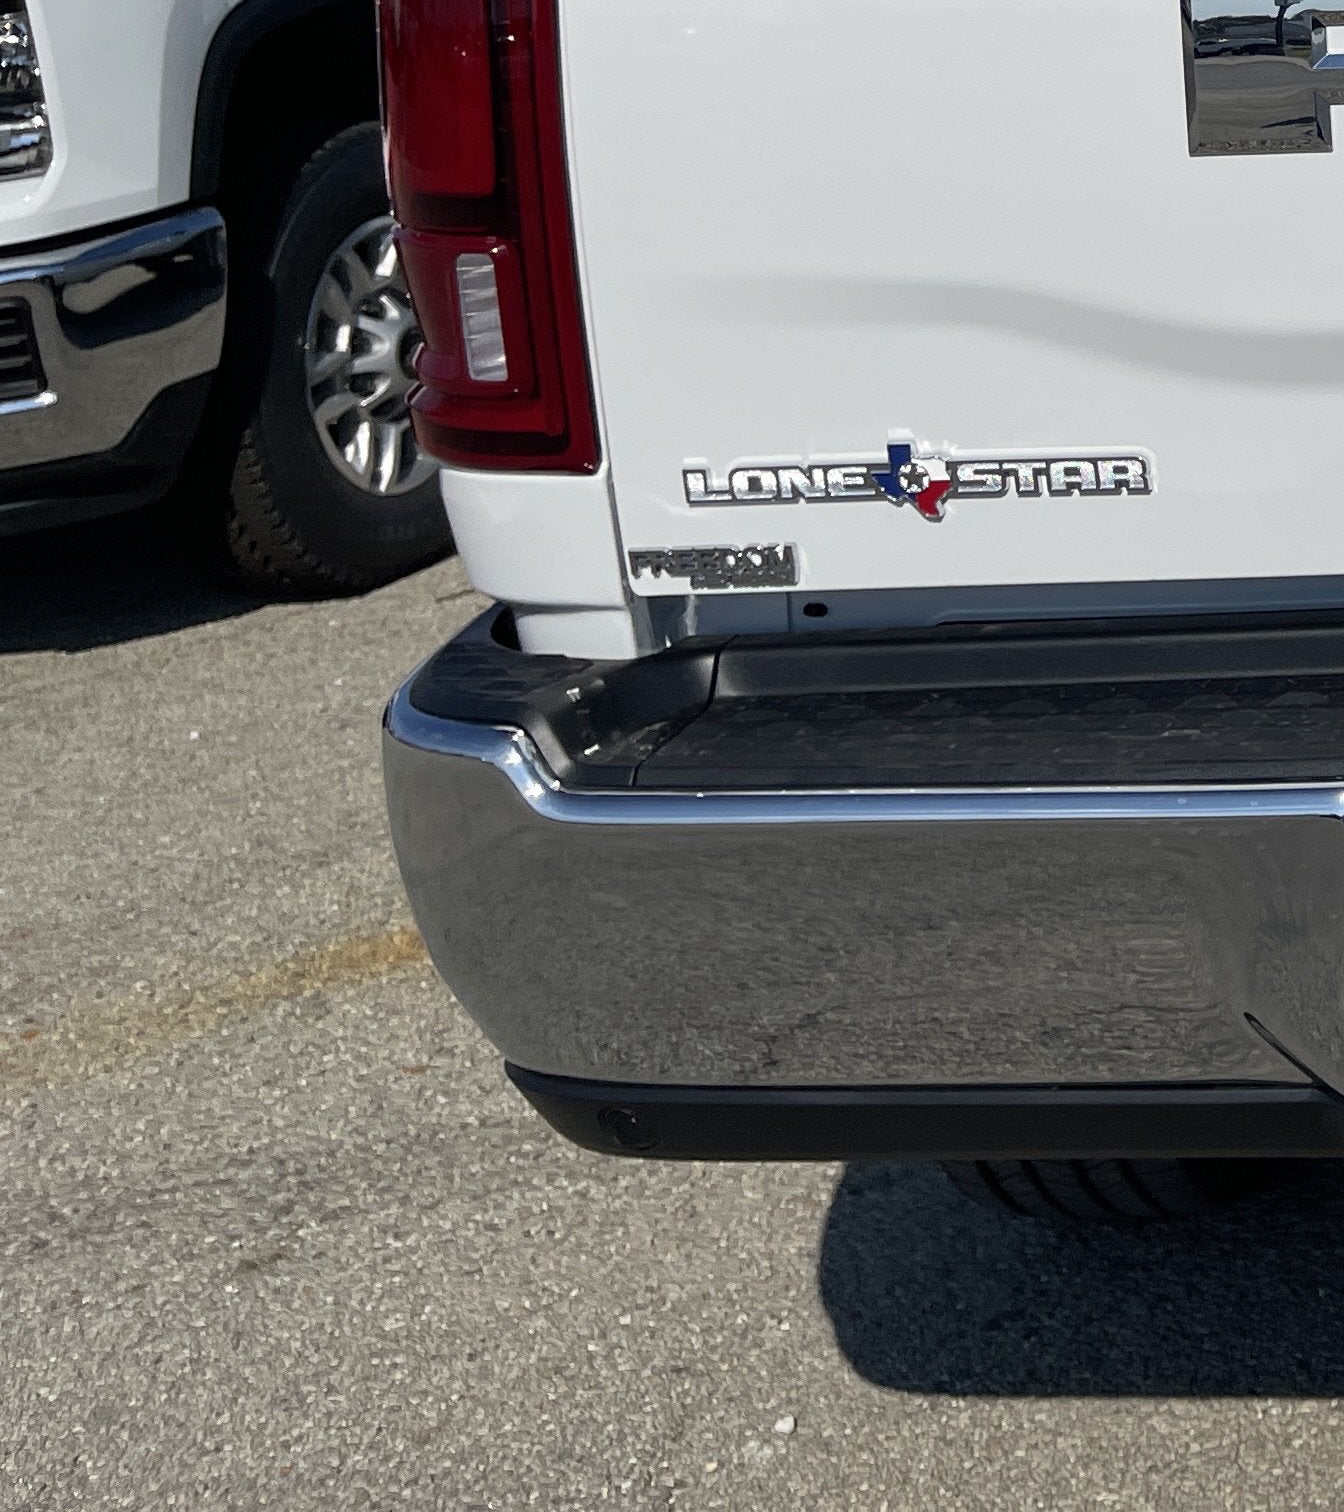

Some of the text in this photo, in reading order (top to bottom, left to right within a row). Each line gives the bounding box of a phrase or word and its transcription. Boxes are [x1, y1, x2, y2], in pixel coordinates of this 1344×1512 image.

[683, 457, 1152, 505] LONE STAR
[628, 545, 796, 580] FREEDOM
